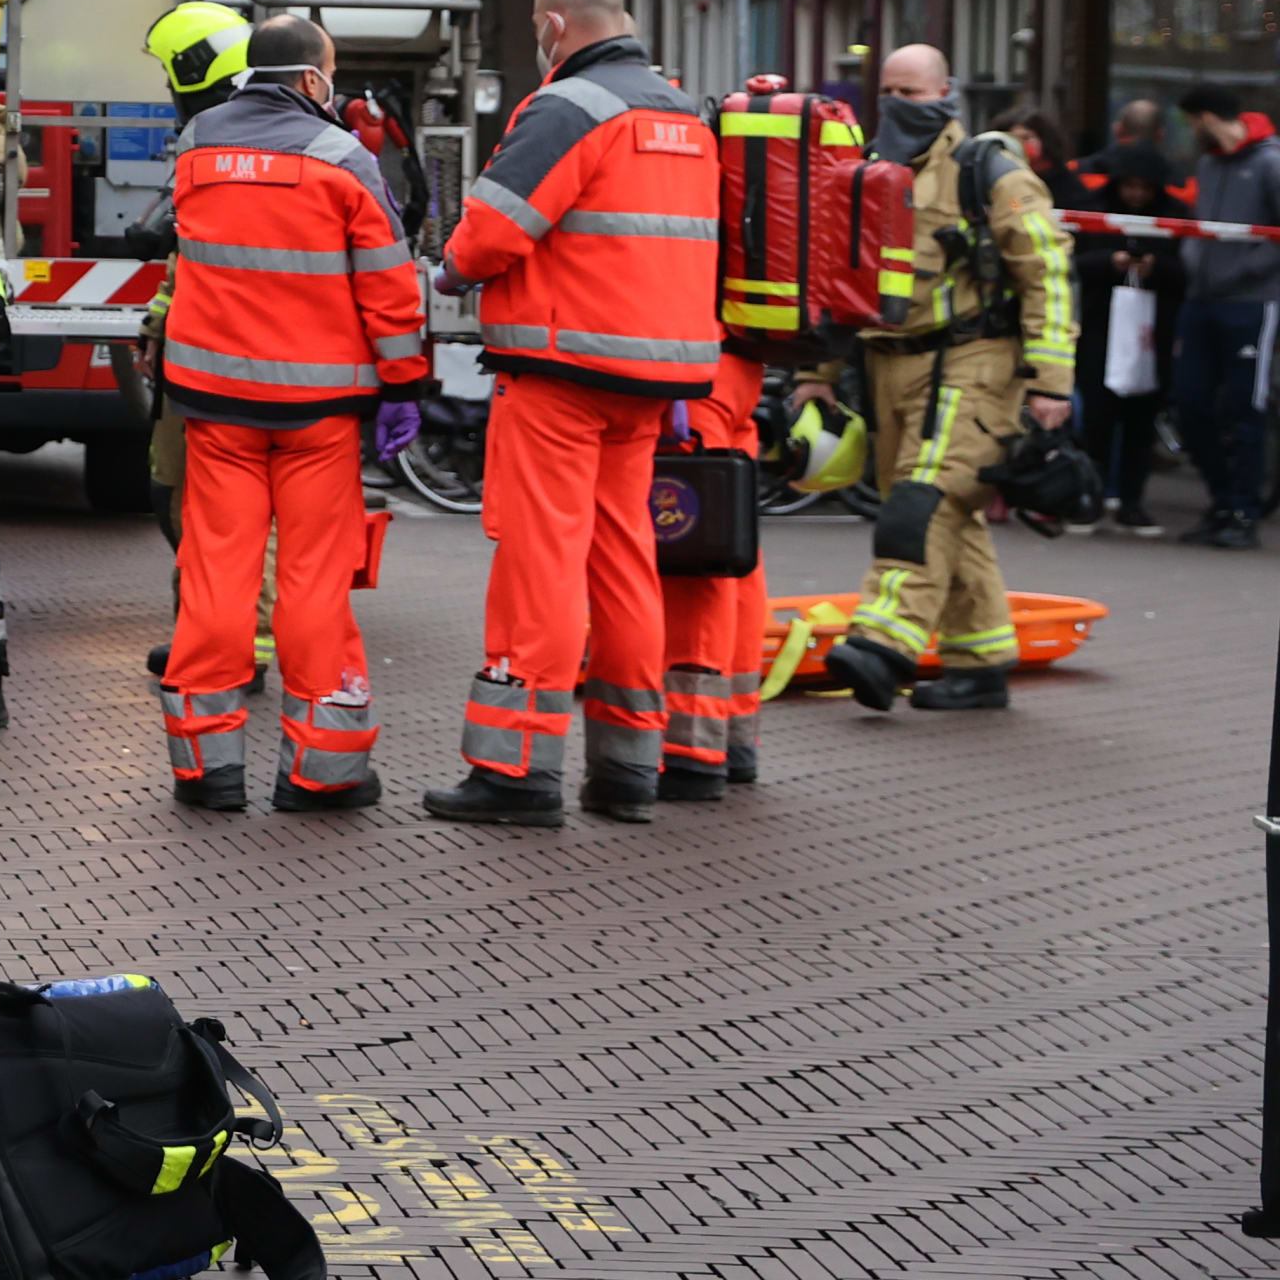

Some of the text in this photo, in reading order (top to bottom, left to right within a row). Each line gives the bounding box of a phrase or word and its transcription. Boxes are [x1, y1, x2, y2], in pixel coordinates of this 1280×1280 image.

[216, 154, 274, 172] MMT
[312, 1093, 554, 1263] BINNENSTAD
[464, 1134, 634, 1233] FIETSERS
